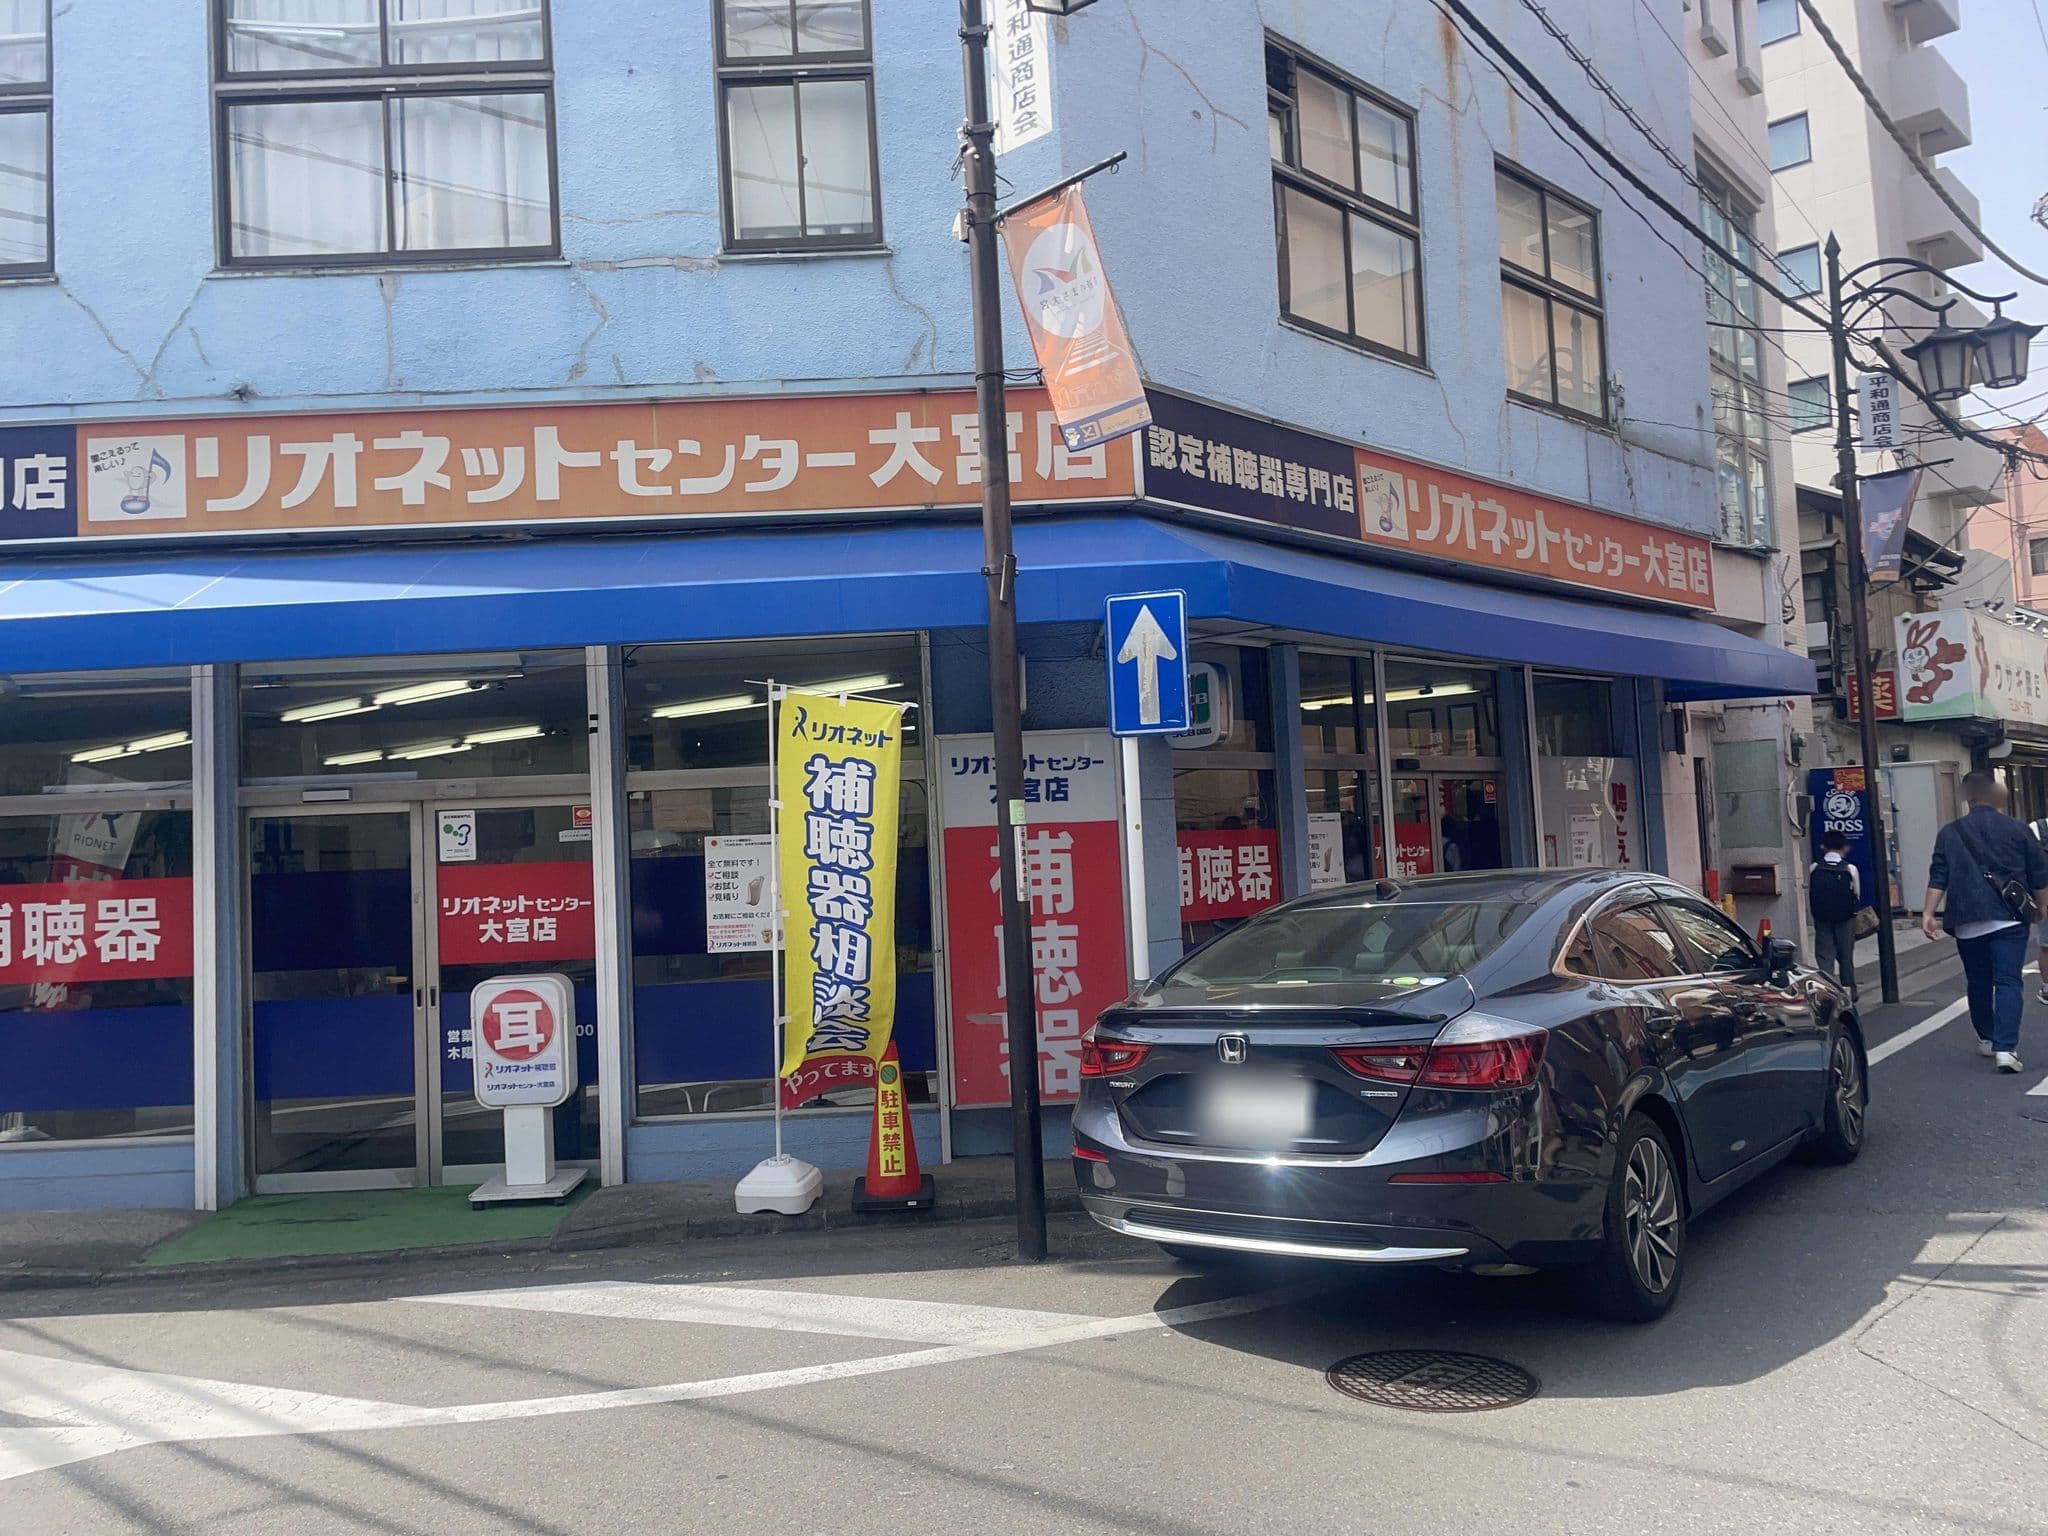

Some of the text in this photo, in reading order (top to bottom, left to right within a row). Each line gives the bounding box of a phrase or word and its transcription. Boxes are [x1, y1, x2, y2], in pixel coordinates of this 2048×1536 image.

[1869, 376, 1894, 448] 平和通商店会
[0, 453, 67, 511] 店
[196, 410, 1107, 512] リオネットセンター大宮店
[1149, 425, 1355, 513] 認定補聴器専門店
[1408, 479, 1710, 595] リオネットセンター大宮店
[812, 720, 893, 748] リオネット
[951, 754, 1104, 775] リオトセンター
[442, 894, 592, 915] リオネットセンター
[479, 917, 557, 943] 大宮店
[805, 754, 876, 1053] 補聴器相談会
[989, 829, 1083, 1096] 補聴器
[492, 1000, 545, 1053] 耳
[784, 1060, 875, 1094] やってます
[881, 1090, 903, 1173] 駐車禁止
